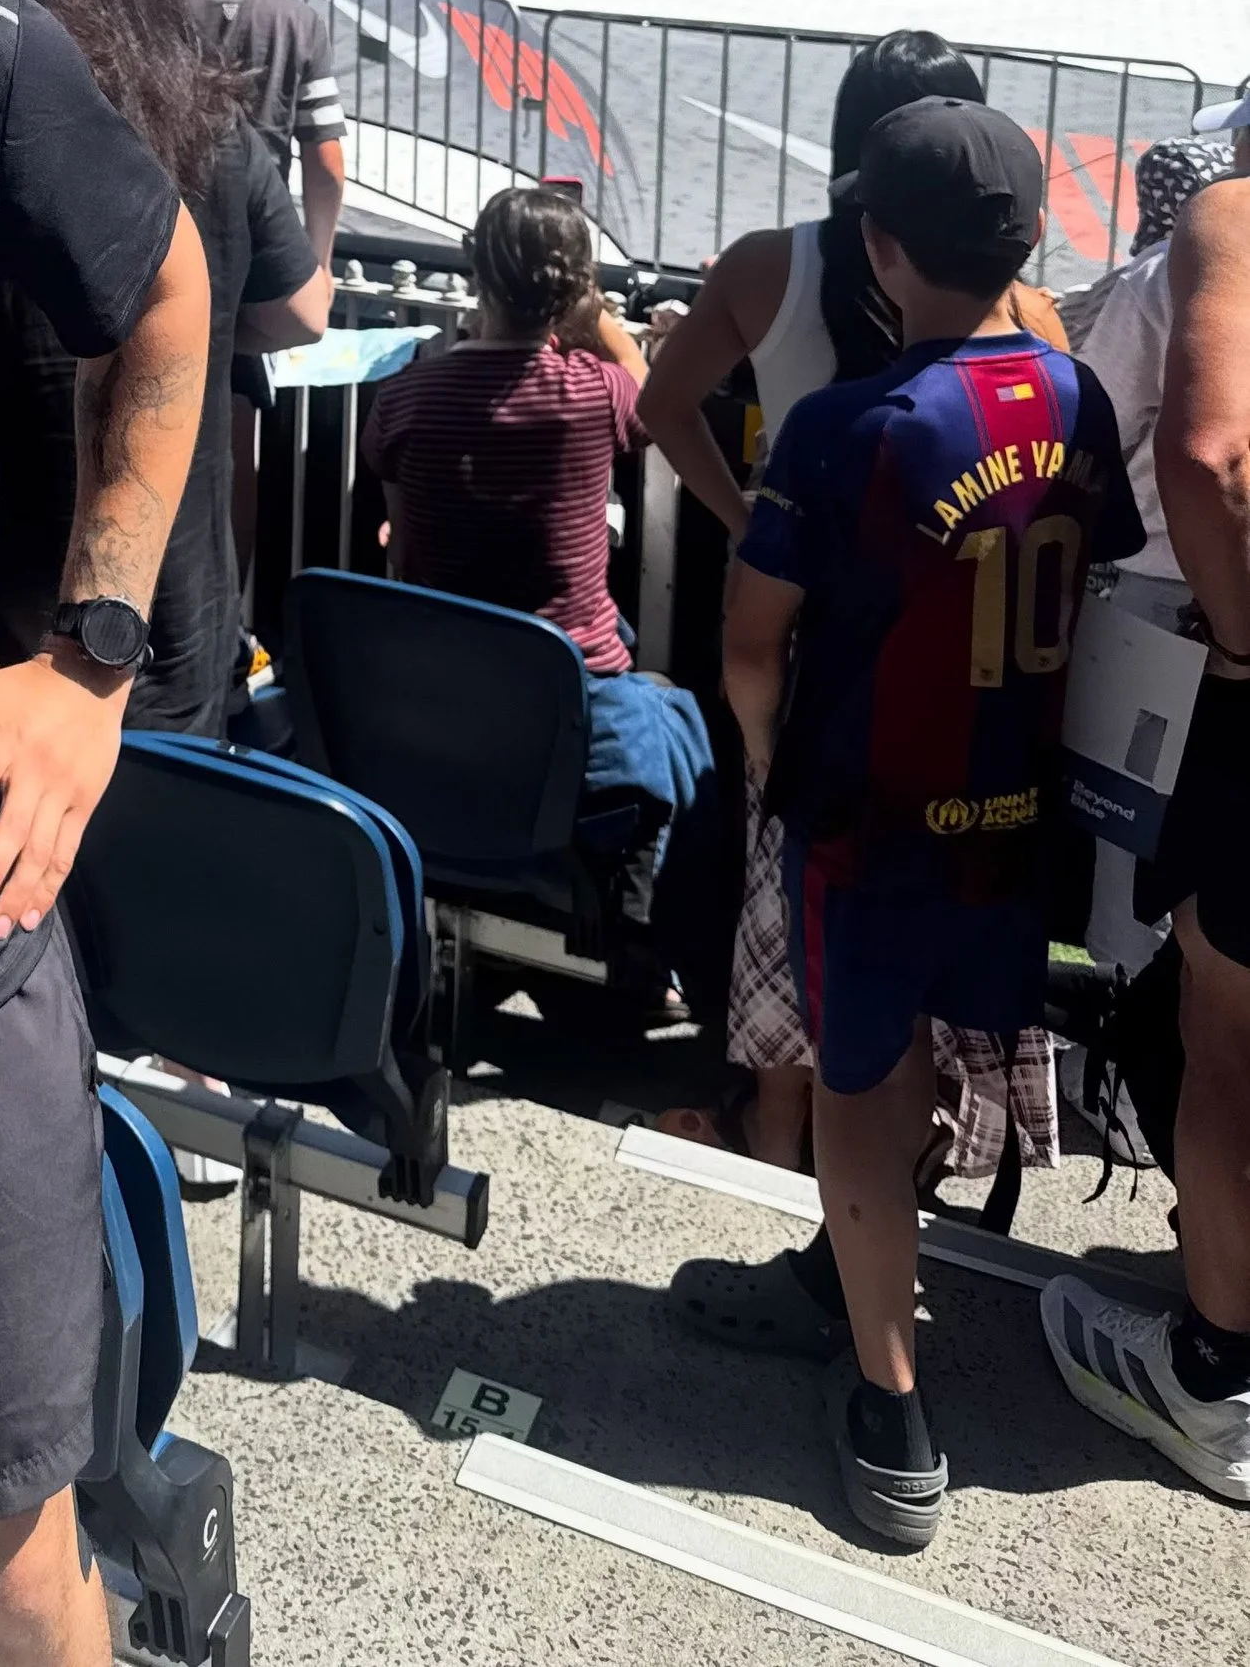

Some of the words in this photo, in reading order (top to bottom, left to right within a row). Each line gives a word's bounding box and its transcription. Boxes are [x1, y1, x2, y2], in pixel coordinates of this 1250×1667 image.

[915, 443, 1025, 547] LAMINE
[954, 514, 1084, 688] 10
[1072, 778, 1136, 822] Beyond
[470, 1383, 511, 1417] B
[442, 1409, 481, 1436] 15
